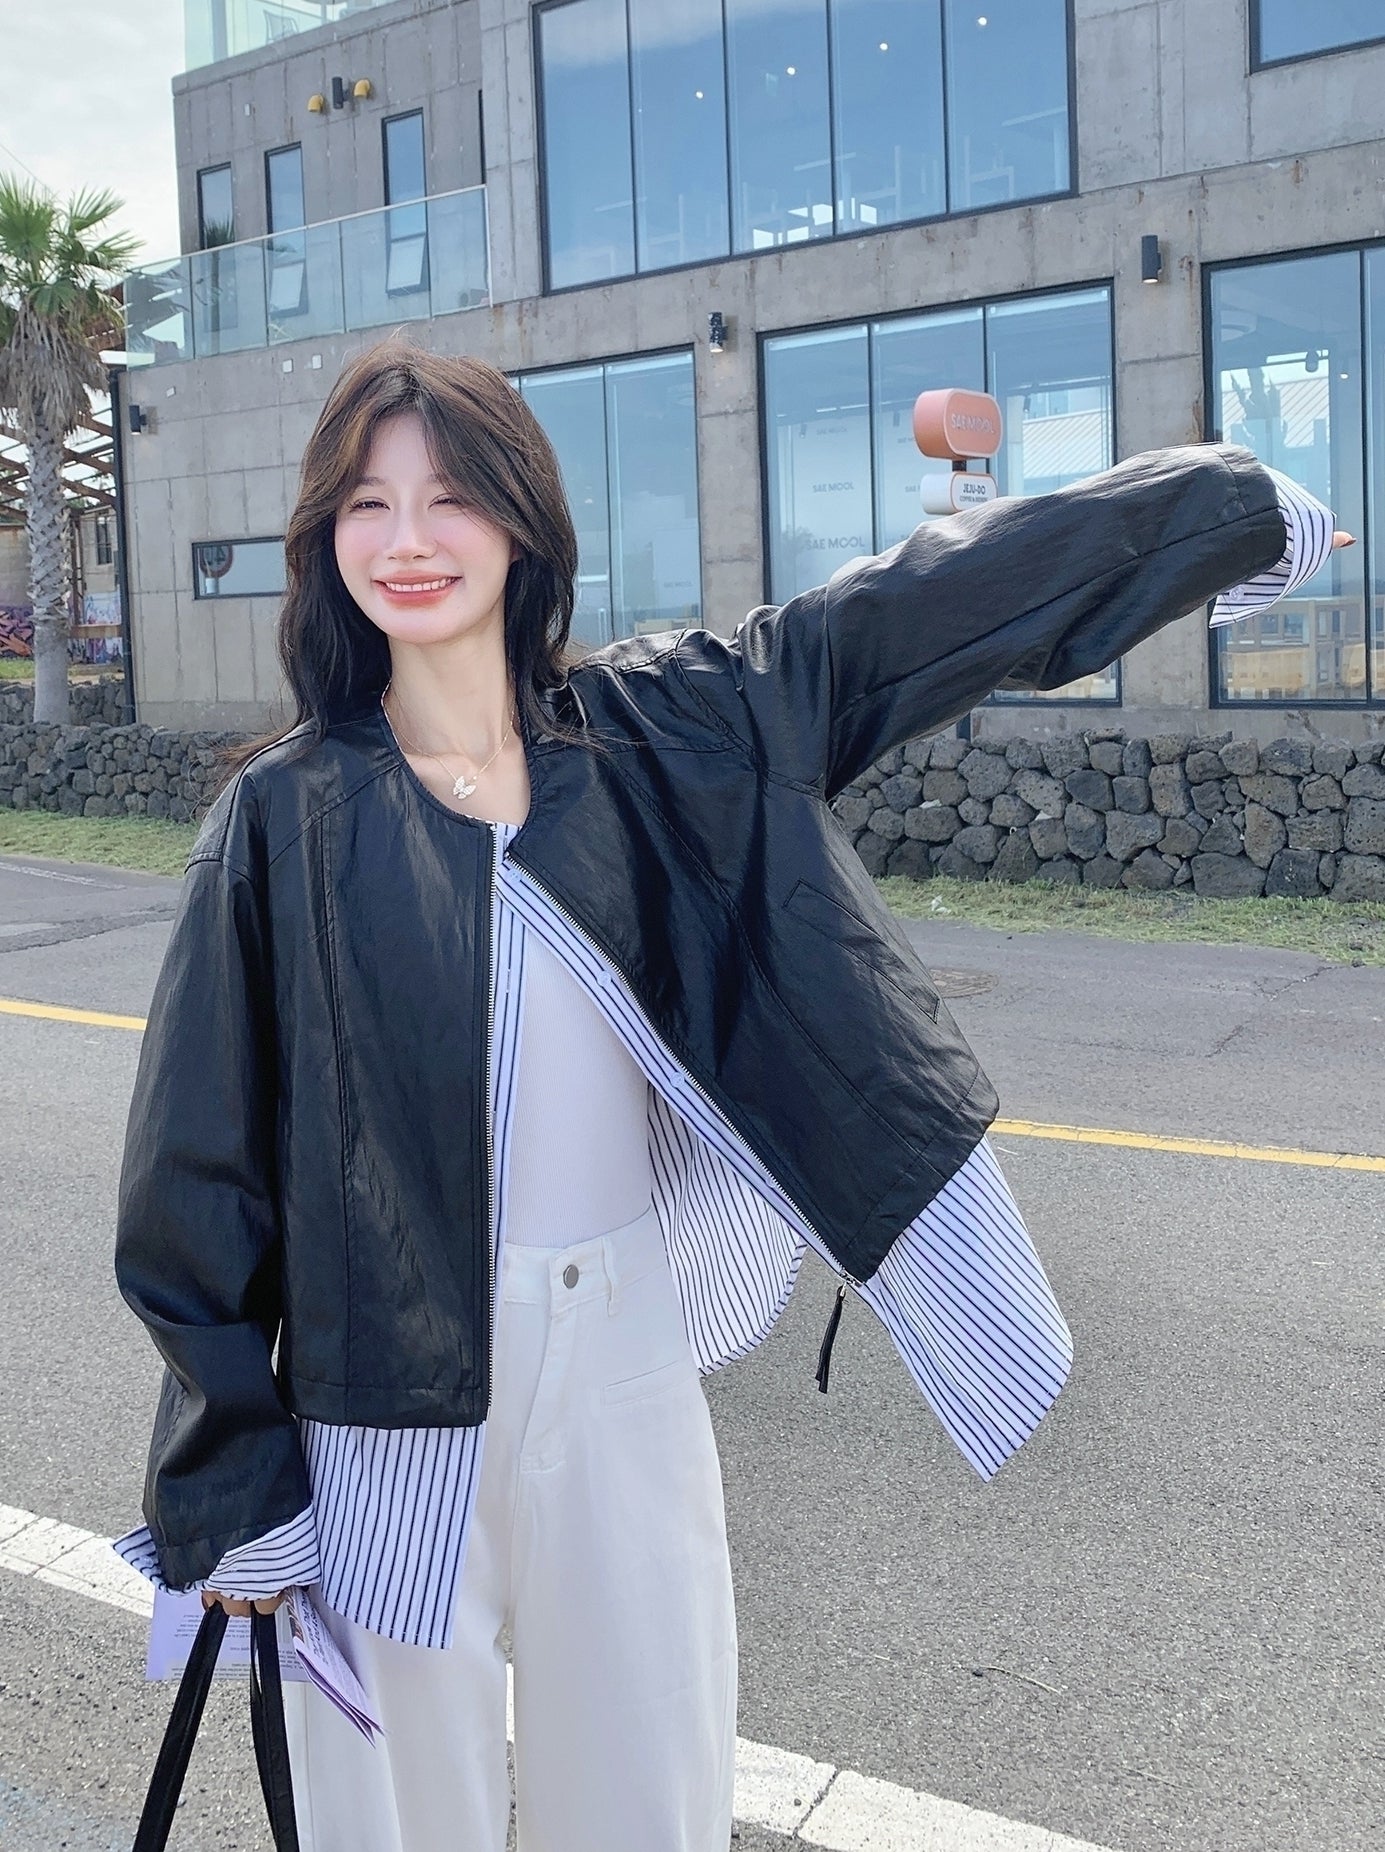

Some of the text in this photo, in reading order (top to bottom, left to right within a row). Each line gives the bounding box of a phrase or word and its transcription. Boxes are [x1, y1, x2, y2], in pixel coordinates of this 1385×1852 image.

[952, 413, 966, 430] SAE
[813, 482, 854, 493] SAE MOOL
[963, 483, 985, 495] JEJU-DO
[806, 536, 865, 550] SAE MOOL
